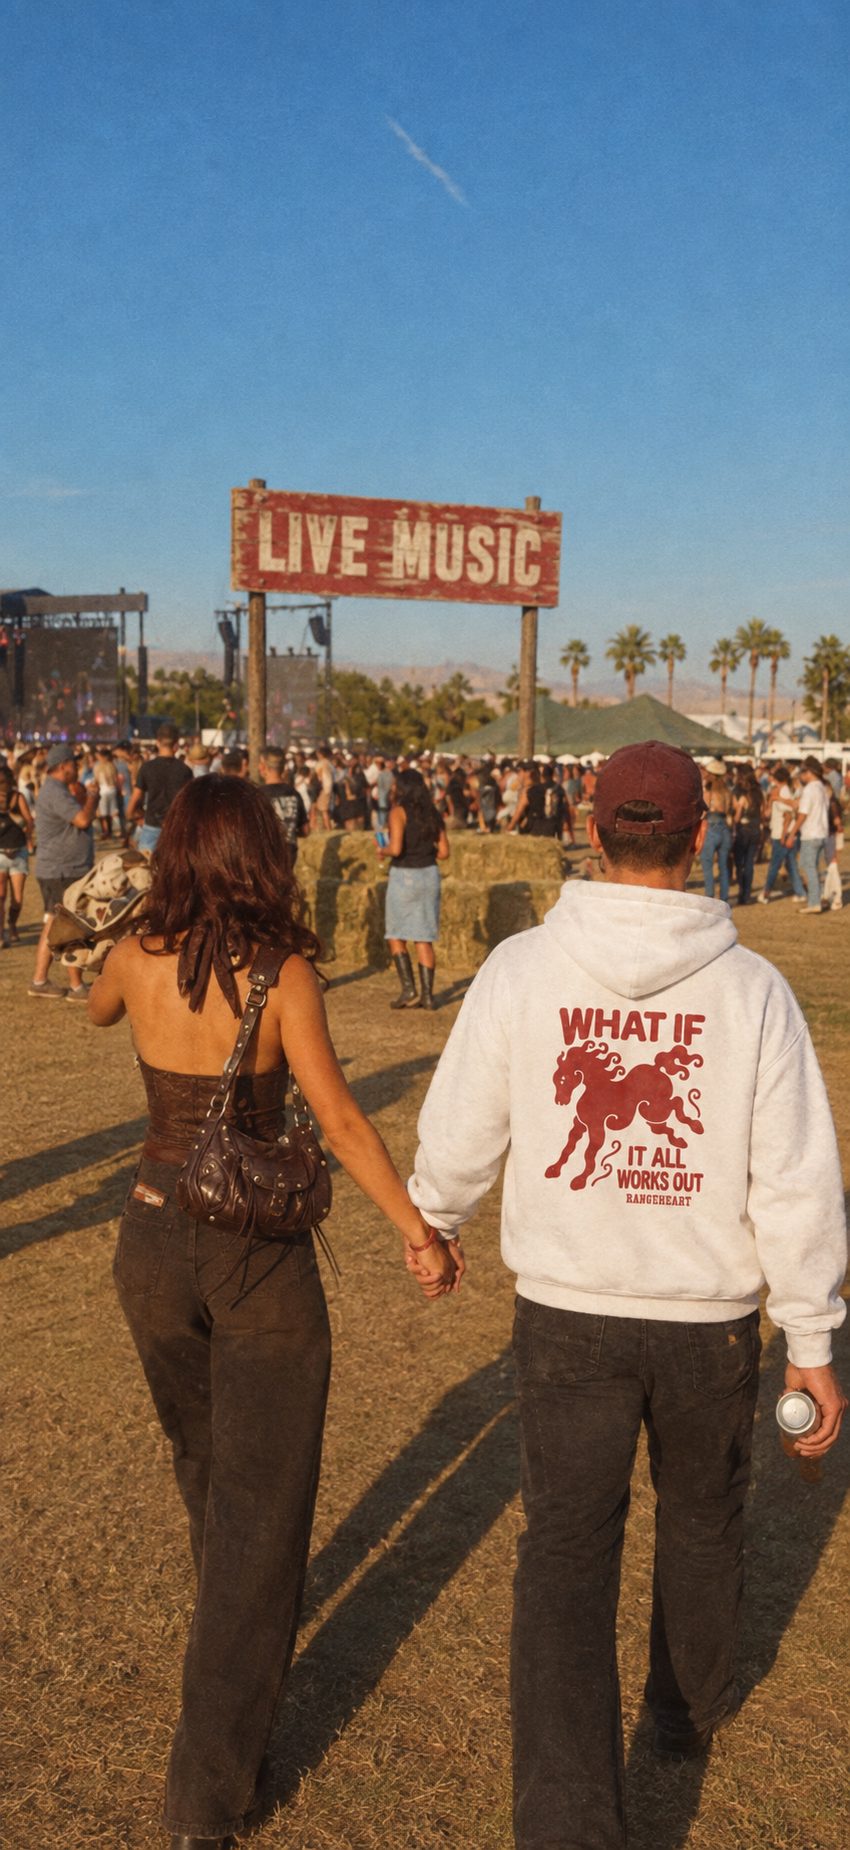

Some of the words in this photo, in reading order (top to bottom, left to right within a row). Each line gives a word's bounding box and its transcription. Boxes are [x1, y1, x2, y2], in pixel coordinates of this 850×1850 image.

[258, 510, 368, 577] LIVE
[392, 519, 541, 587] MUSIC
[559, 1007, 667, 1046] WHAT
[673, 1013, 706, 1046] IF
[628, 1145, 647, 1167] IT
[651, 1147, 687, 1169] ALL
[617, 1168, 669, 1192] WORKS
[673, 1171, 704, 1193] OUT
[626, 1193, 692, 1207] RANGEHEART
